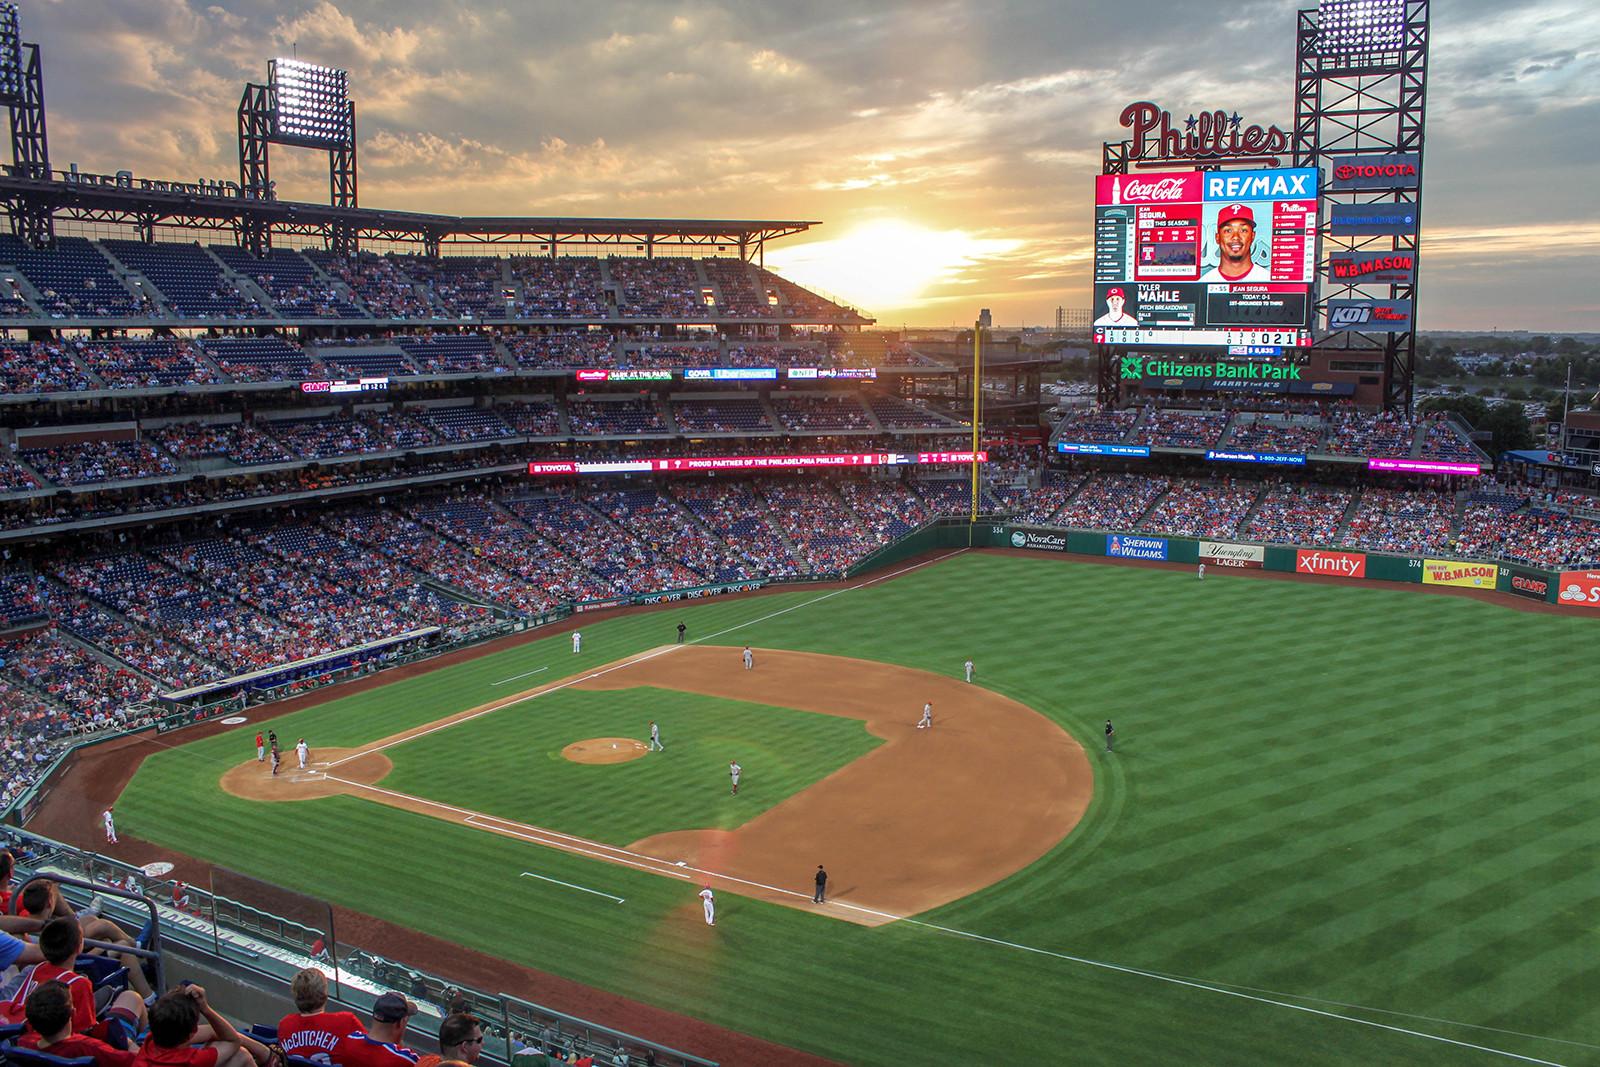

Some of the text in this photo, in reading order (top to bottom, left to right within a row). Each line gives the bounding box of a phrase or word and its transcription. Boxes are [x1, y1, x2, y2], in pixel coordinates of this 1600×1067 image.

[1120, 102, 1288, 159] Phillies
[1356, 164, 1416, 178] TOYOTA
[1123, 177, 1187, 200] Coca-Cola
[1209, 175, 1307, 197] RE/MAX
[1137, 291, 1180, 302] MAHLE
[1261, 333, 1293, 344] 0 2 1
[1146, 361, 1300, 380] Citizens Bank Park
[302, 382, 330, 393] GIANT
[541, 464, 572, 472] TOYOTA
[768, 458, 815, 466] PHILADELPHIA
[1027, 533, 1066, 545] NovaCare
[1122, 536, 1163, 549] SHERWIN
[1207, 544, 1257, 559] Yuengling
[1216, 558, 1245, 568] LAGER
[1300, 552, 1361, 576] xfinity
[1408, 560, 1421, 568] 374
[728, 583, 761, 593] DISCOVER
[1512, 576, 1547, 595] GIANT
[644, 593, 681, 605] DISCOVER
[687, 588, 722, 599] DISCOVER
[281, 1030, 340, 1053] McCUTCHEN
